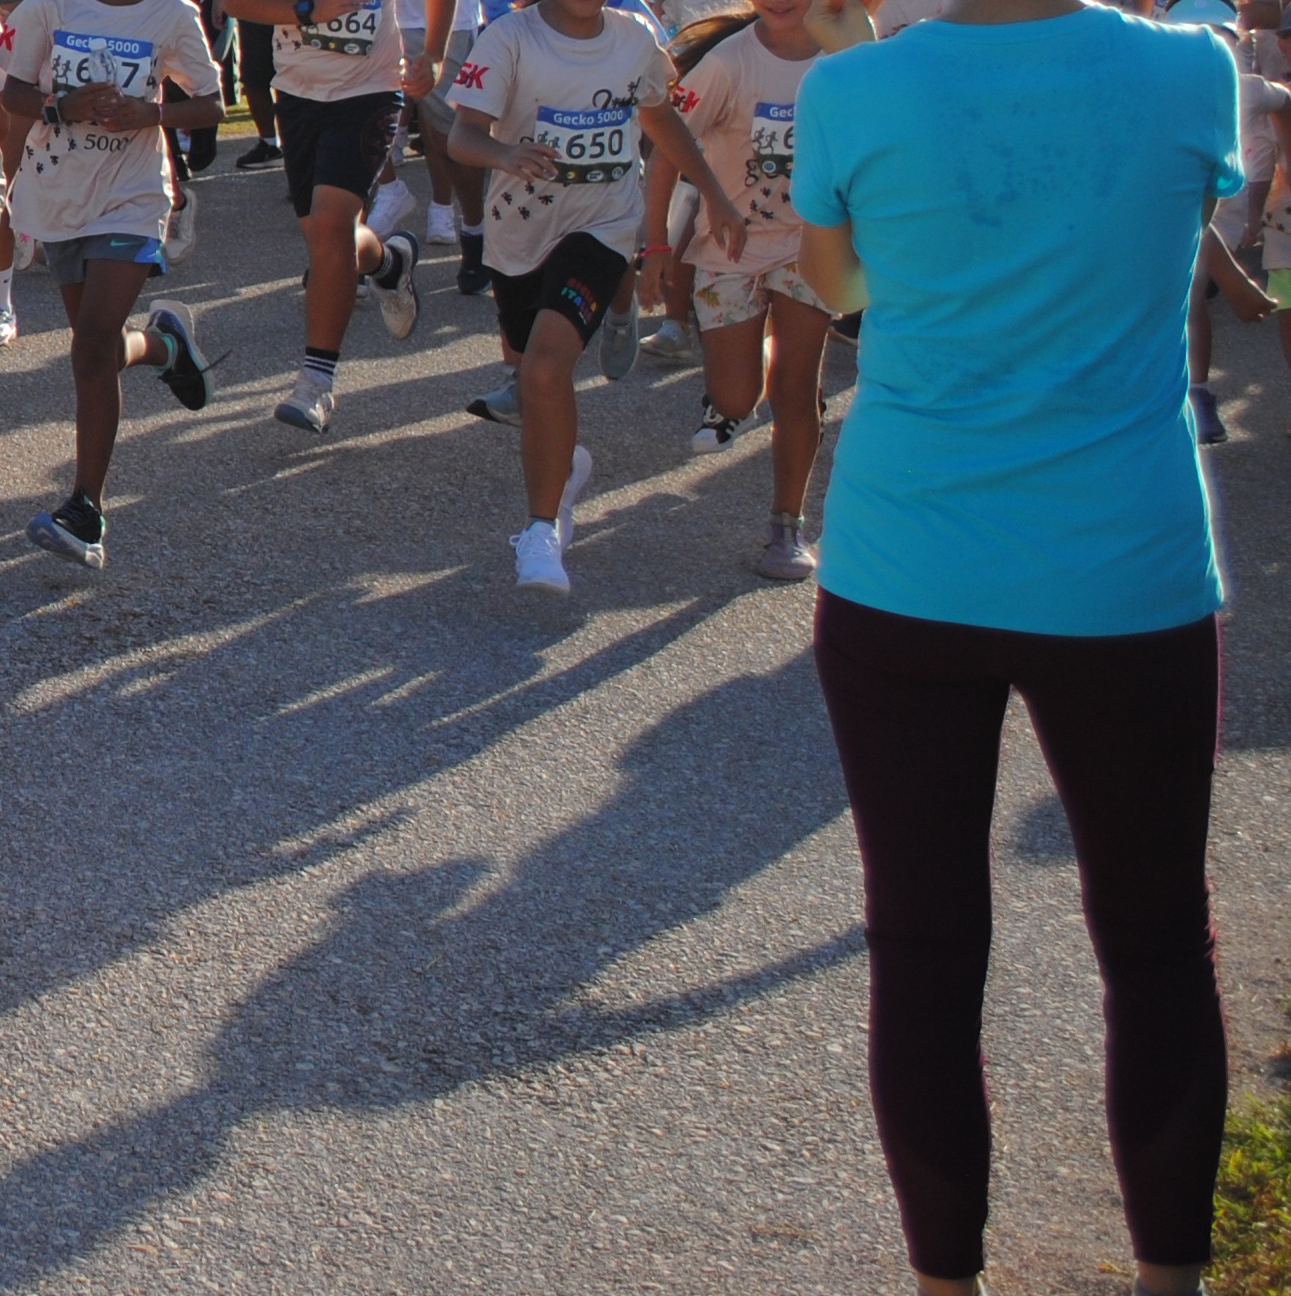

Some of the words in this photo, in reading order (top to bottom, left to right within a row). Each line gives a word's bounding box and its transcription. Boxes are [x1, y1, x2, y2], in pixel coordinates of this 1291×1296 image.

[108, 42, 140, 54] 5000
[75, 57, 140, 89] 67
[453, 62, 491, 90] 5K
[553, 112, 595, 126] Gecko
[597, 109, 624, 125] 5000
[565, 129, 624, 159] 650
